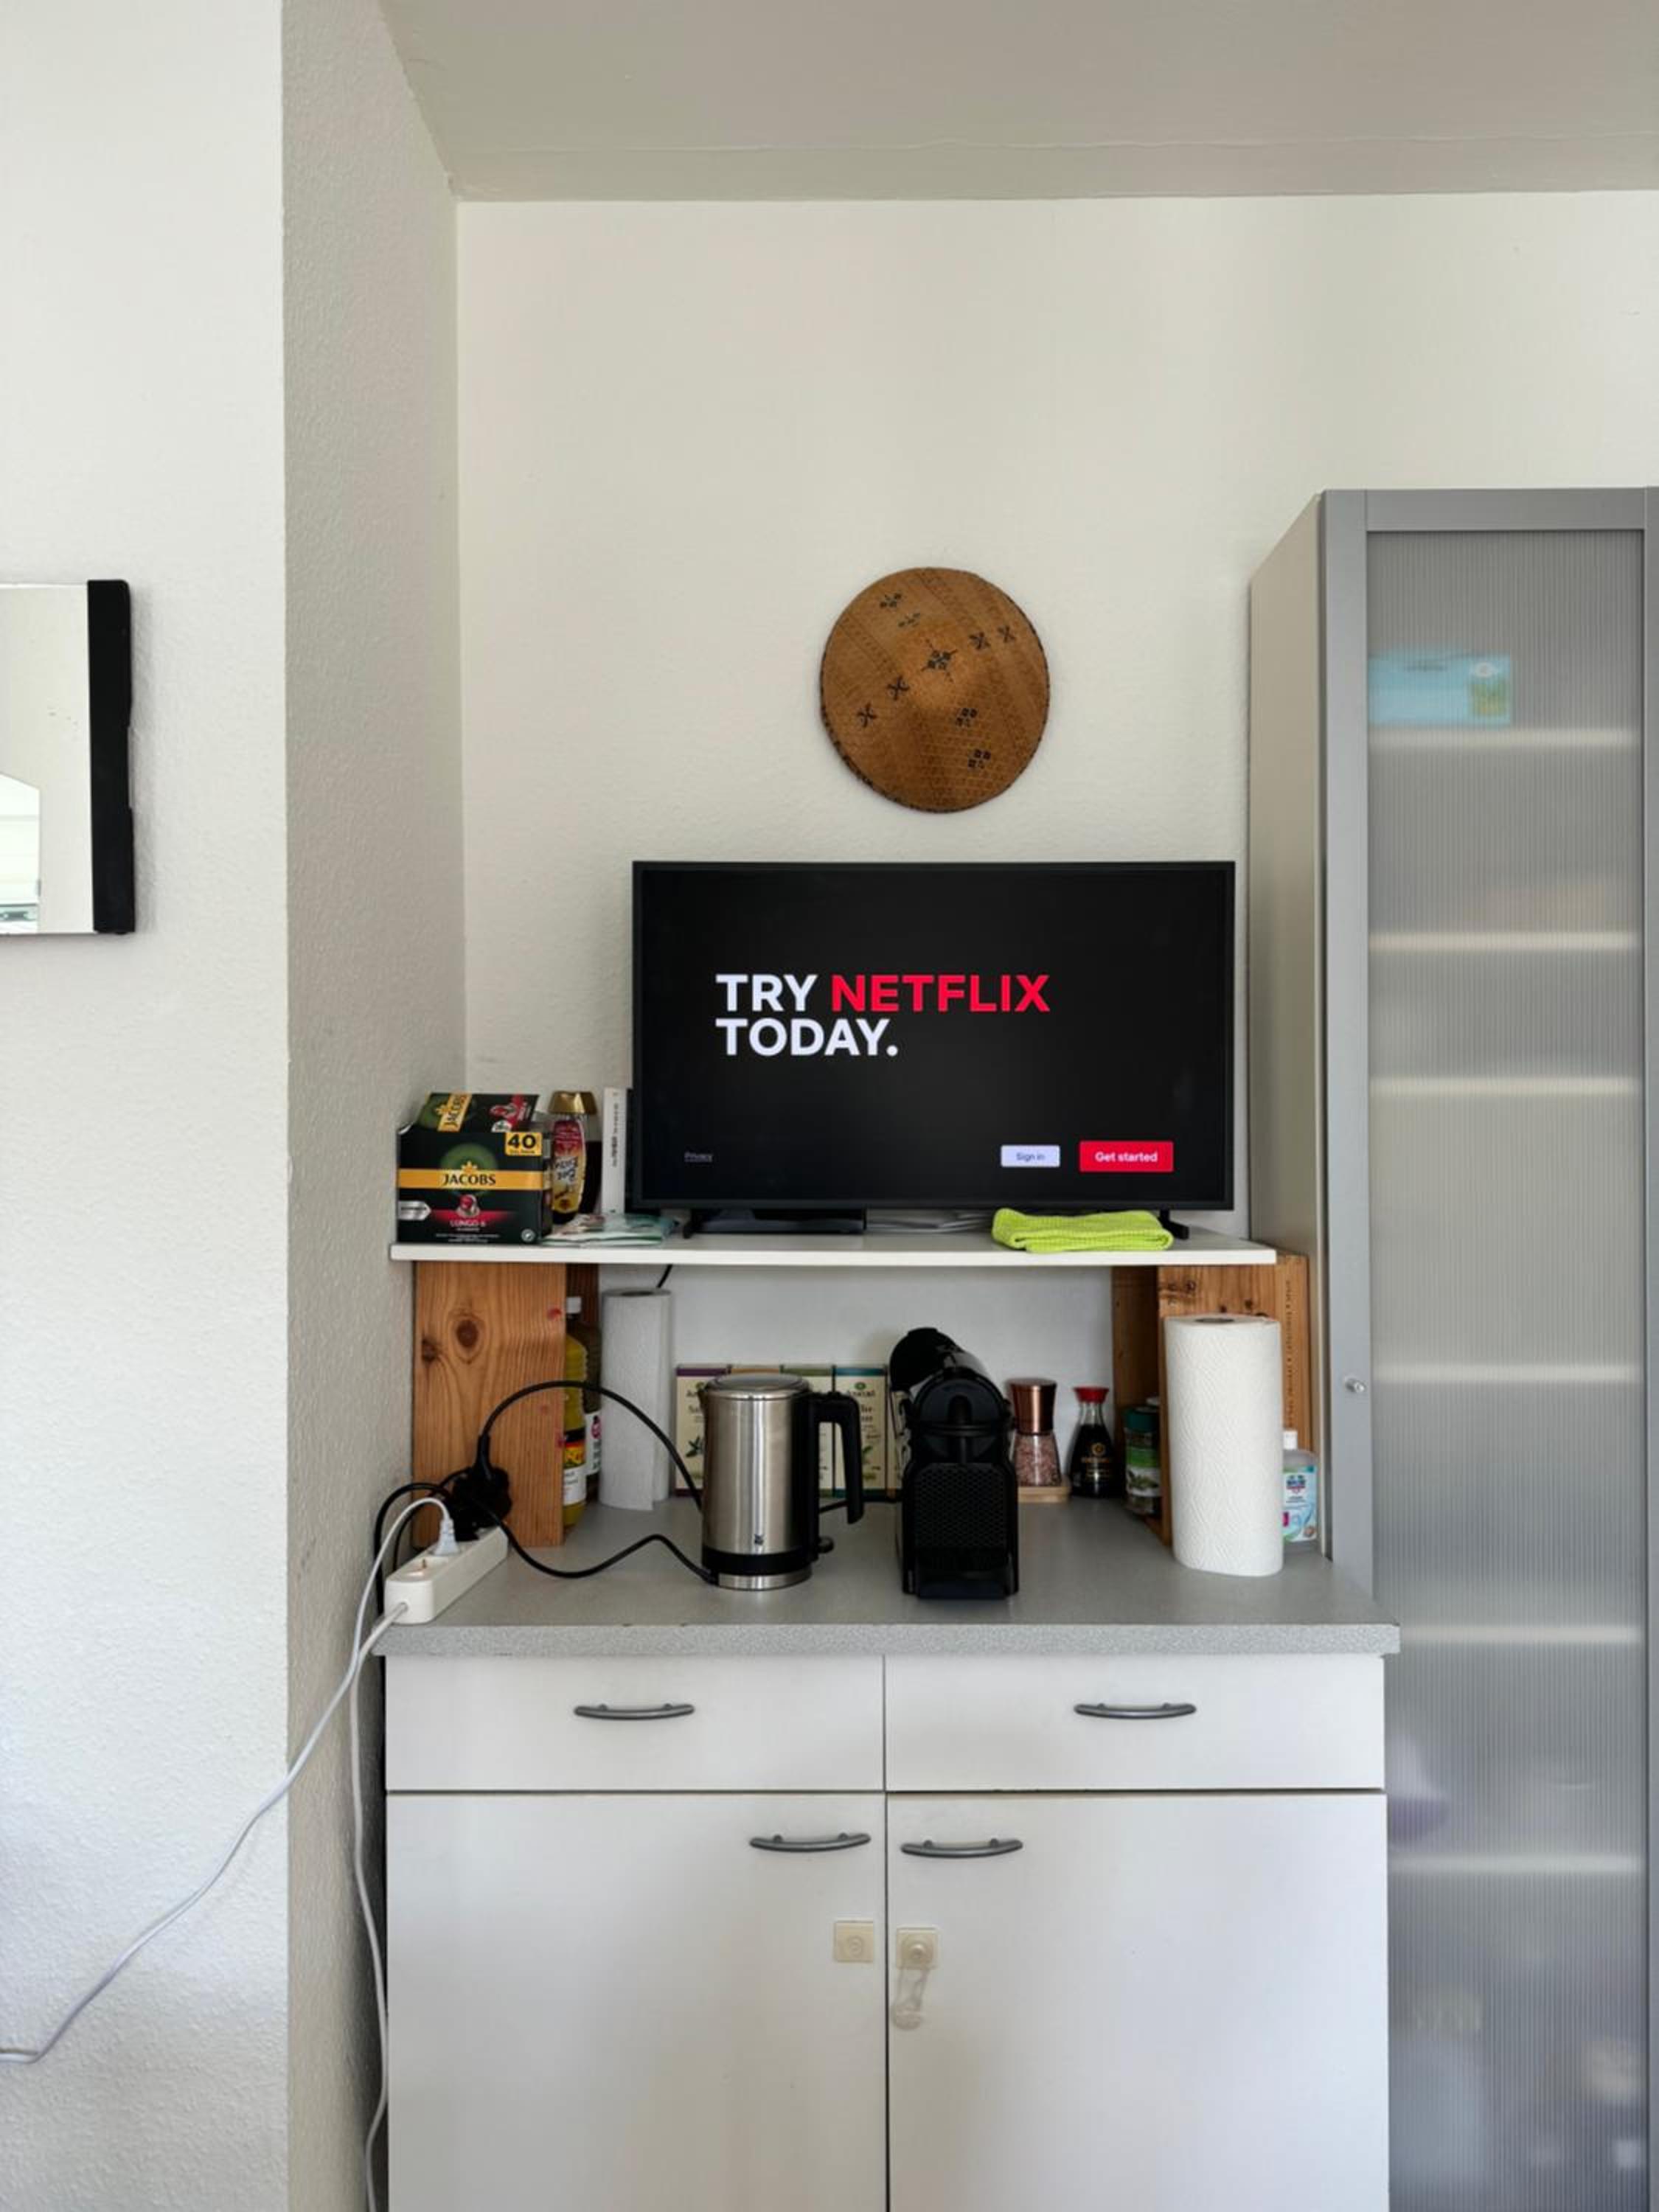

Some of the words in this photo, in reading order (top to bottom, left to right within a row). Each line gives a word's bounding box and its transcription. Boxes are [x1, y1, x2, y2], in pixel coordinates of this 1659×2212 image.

[715, 974, 818, 1012] TRY
[832, 974, 1050, 1012] NETFLIX
[715, 1018, 899, 1056] TODAY.
[507, 1134, 537, 1150] 40
[1016, 1152, 1034, 1162] Sign
[1036, 1152, 1045, 1161] in
[1095, 1151, 1116, 1162] Get
[1118, 1151, 1158, 1162] started
[443, 1173, 496, 1186] JACOBS
